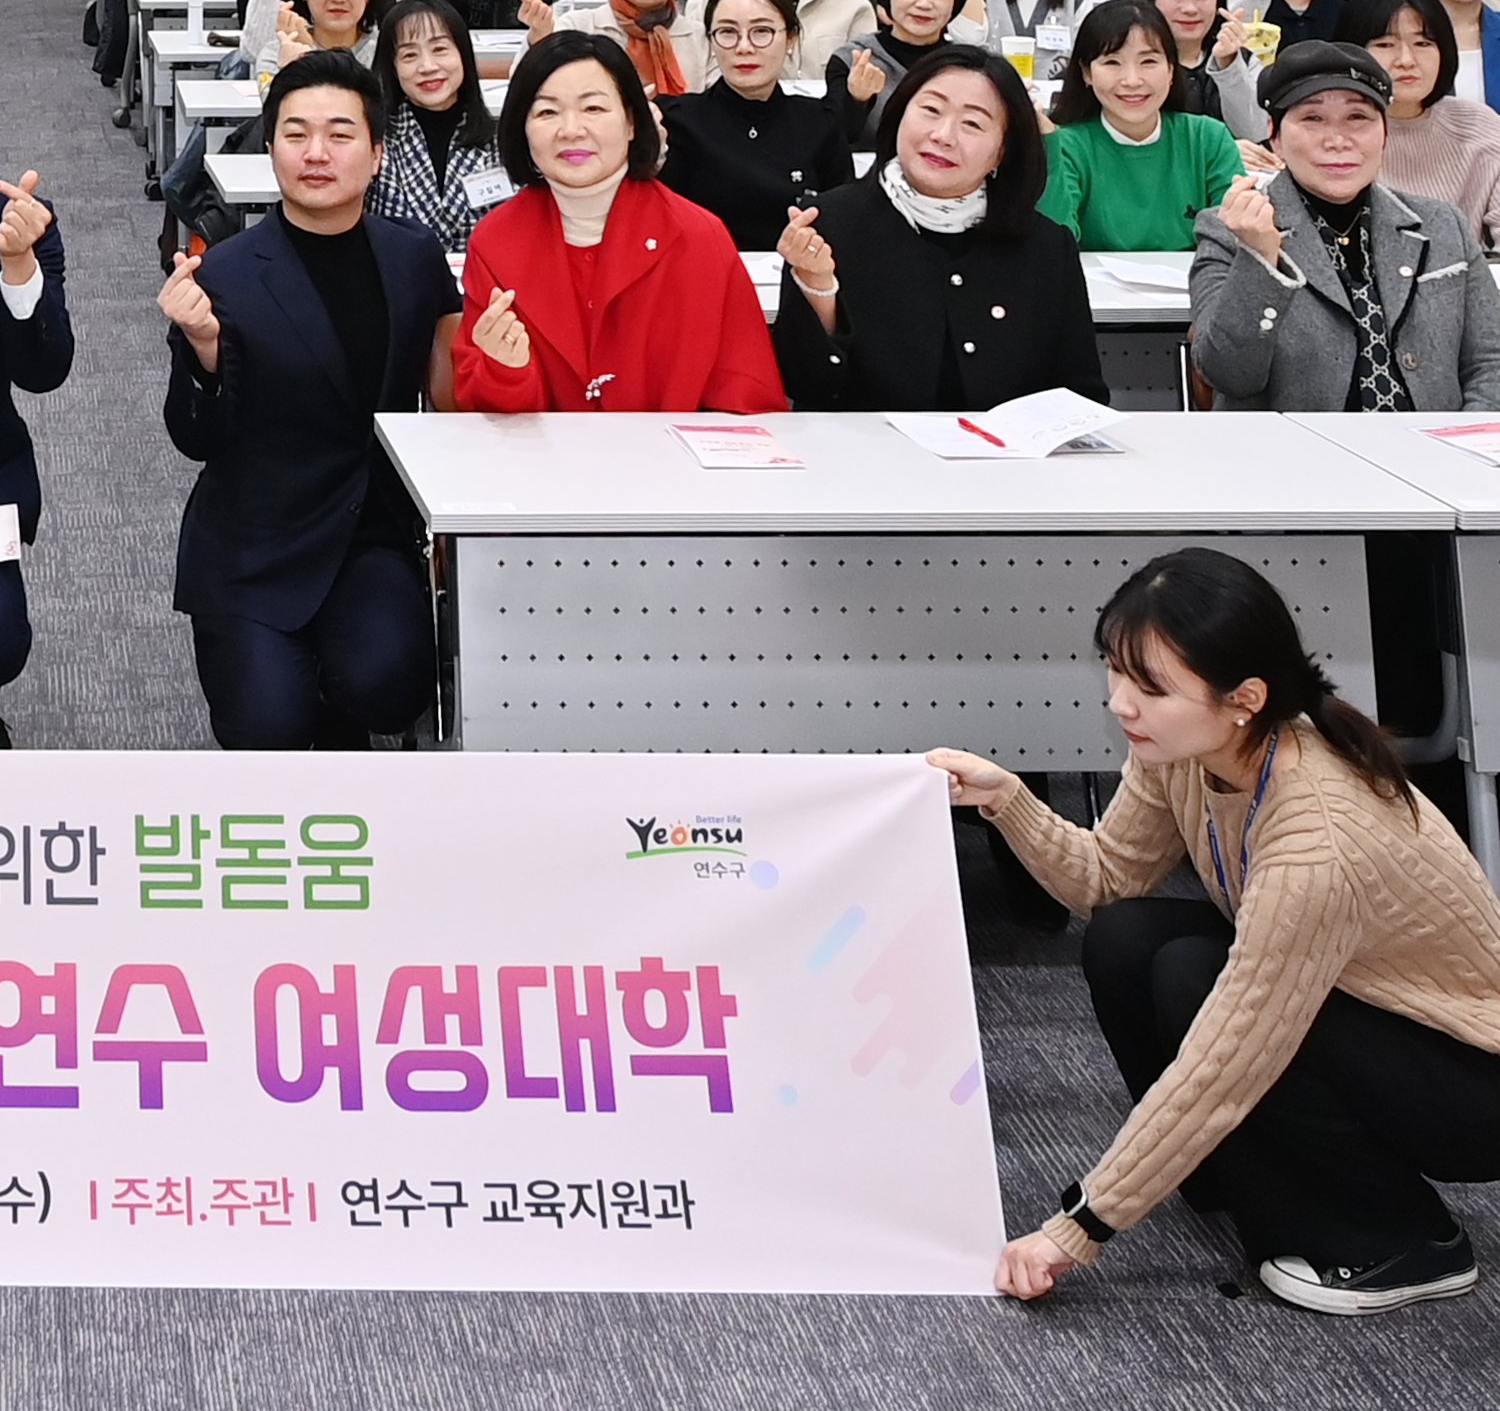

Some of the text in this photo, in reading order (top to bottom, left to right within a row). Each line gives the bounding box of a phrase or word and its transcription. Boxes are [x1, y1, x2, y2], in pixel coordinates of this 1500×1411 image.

[625, 816, 743, 854] Yeonsu
[695, 814, 743, 824] Better life
[134, 813, 374, 911] 발돋움
[693, 861, 746, 880] 연수구
[253, 956, 739, 1114] 여성대학
[340, 1177, 470, 1229] 연수구
[482, 1178, 696, 1231] 교육지원과
